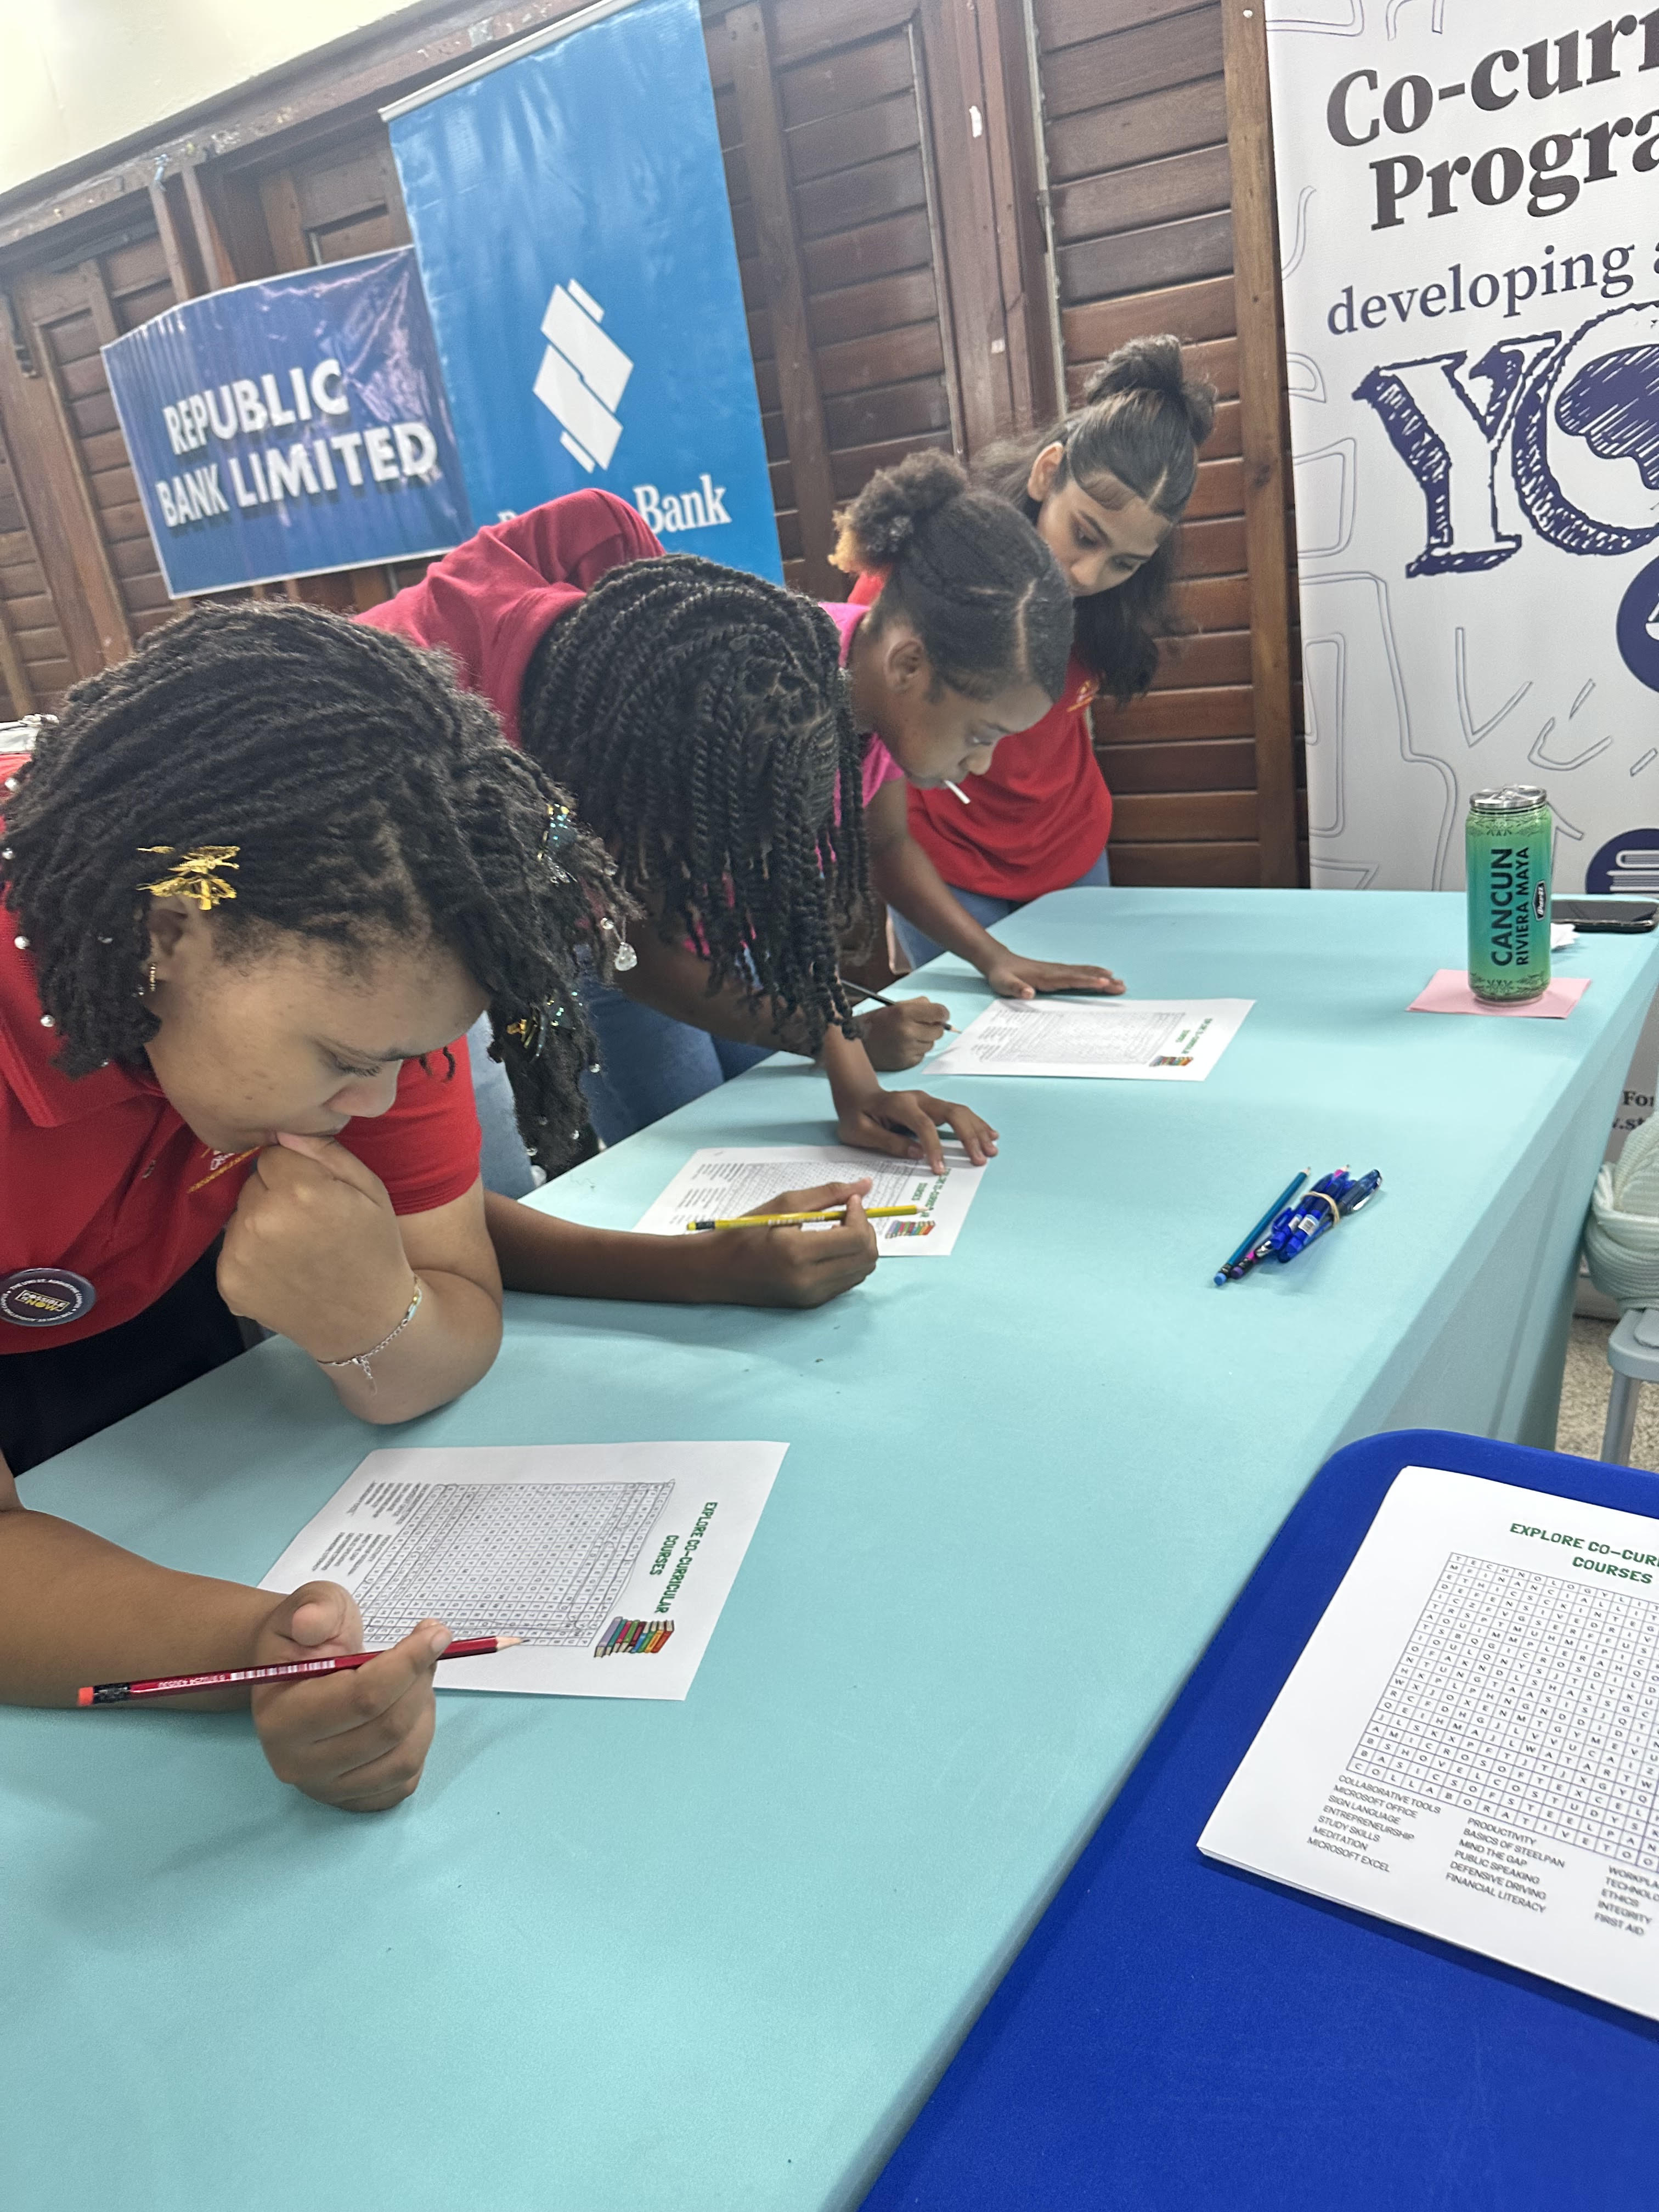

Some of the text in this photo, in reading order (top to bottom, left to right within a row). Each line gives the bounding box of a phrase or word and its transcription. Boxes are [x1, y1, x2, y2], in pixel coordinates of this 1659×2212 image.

[1327, 244, 1635, 335] developing
[163, 359, 349, 455] REPUBLIC
[156, 422, 437, 527] BANK LIMITED
[633, 473, 732, 535] Bank
[1491, 848, 1513, 966] CANCUN
[1515, 847, 1530, 966] RIVIERA MAYA
[26, 1299, 57, 1311] NOW
[1509, 1522, 1585, 1549] EXPLORE
[649, 1534, 680, 1576] COURSES
[654, 1502, 718, 1613] EXPLORE CO-CURRICULAR
[1572, 1556, 1653, 1584] COURSES
[1328, 1795, 1401, 1825] SIGN LANGUAGE
[1334, 1785, 1418, 1819] MICROSOFT OFFICE
[1338, 1775, 1441, 1814] COLLABORATIVE TOOLS
[1313, 1825, 1369, 1851] MEDITATION
[1318, 1815, 1380, 1842] STUDY SKILLS
[1323, 1805, 1415, 1840] ENTREPRENEURSHIP
[1468, 1817, 1537, 1846] PRODUCTIVITY
[1307, 1836, 1390, 1872] MICROSOFT EXCEL
[1459, 1838, 1527, 1866] MIND THE GAP
[1463, 1828, 1565, 1868] BASICS OF STEELPAN
[1449, 1860, 1547, 1900] DEFENSIVE DRIVING
[1454, 1849, 1540, 1885] PUBLIC SPEAKING
[1446, 1872, 1547, 1913] FINANCIAL LITERACY
